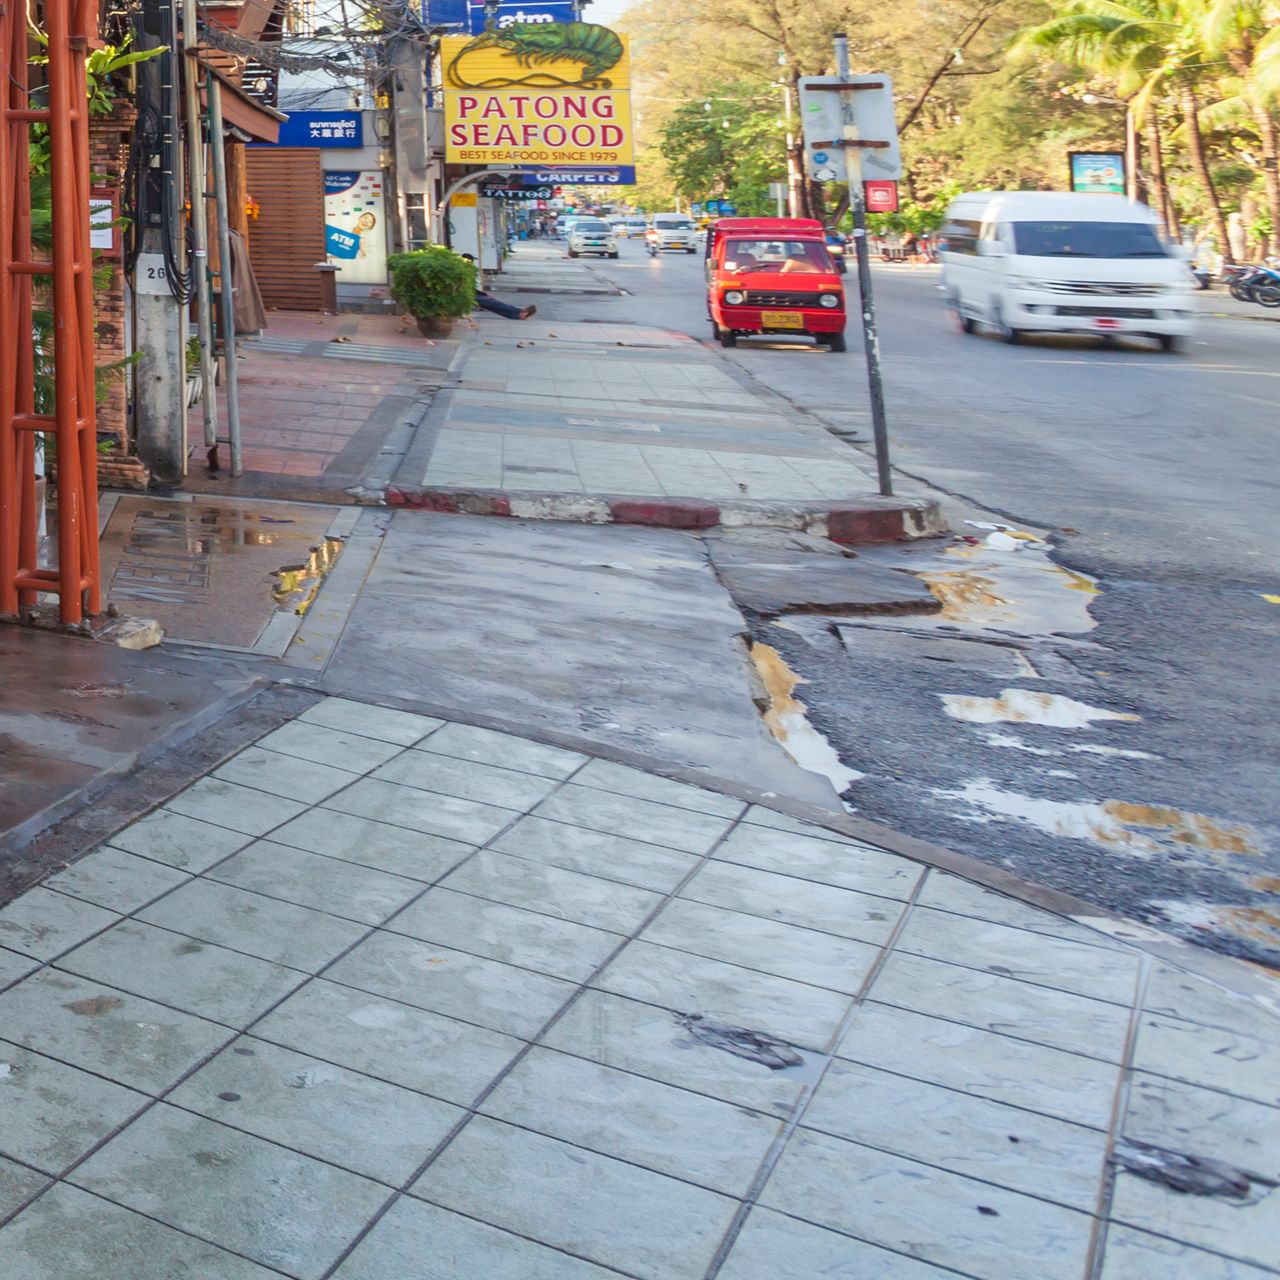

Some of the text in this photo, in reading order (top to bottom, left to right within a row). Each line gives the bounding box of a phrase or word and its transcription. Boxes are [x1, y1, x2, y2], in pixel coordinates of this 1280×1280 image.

[458, 95, 614, 119] PATONG
[451, 124, 624, 147] SEAFOOD
[460, 150, 617, 161] BEST SEAFOOD SINCE 1979
[484, 188, 552, 199] TATTOO
[330, 233, 355, 247] ATM
[147, 267, 166, 279] 26
